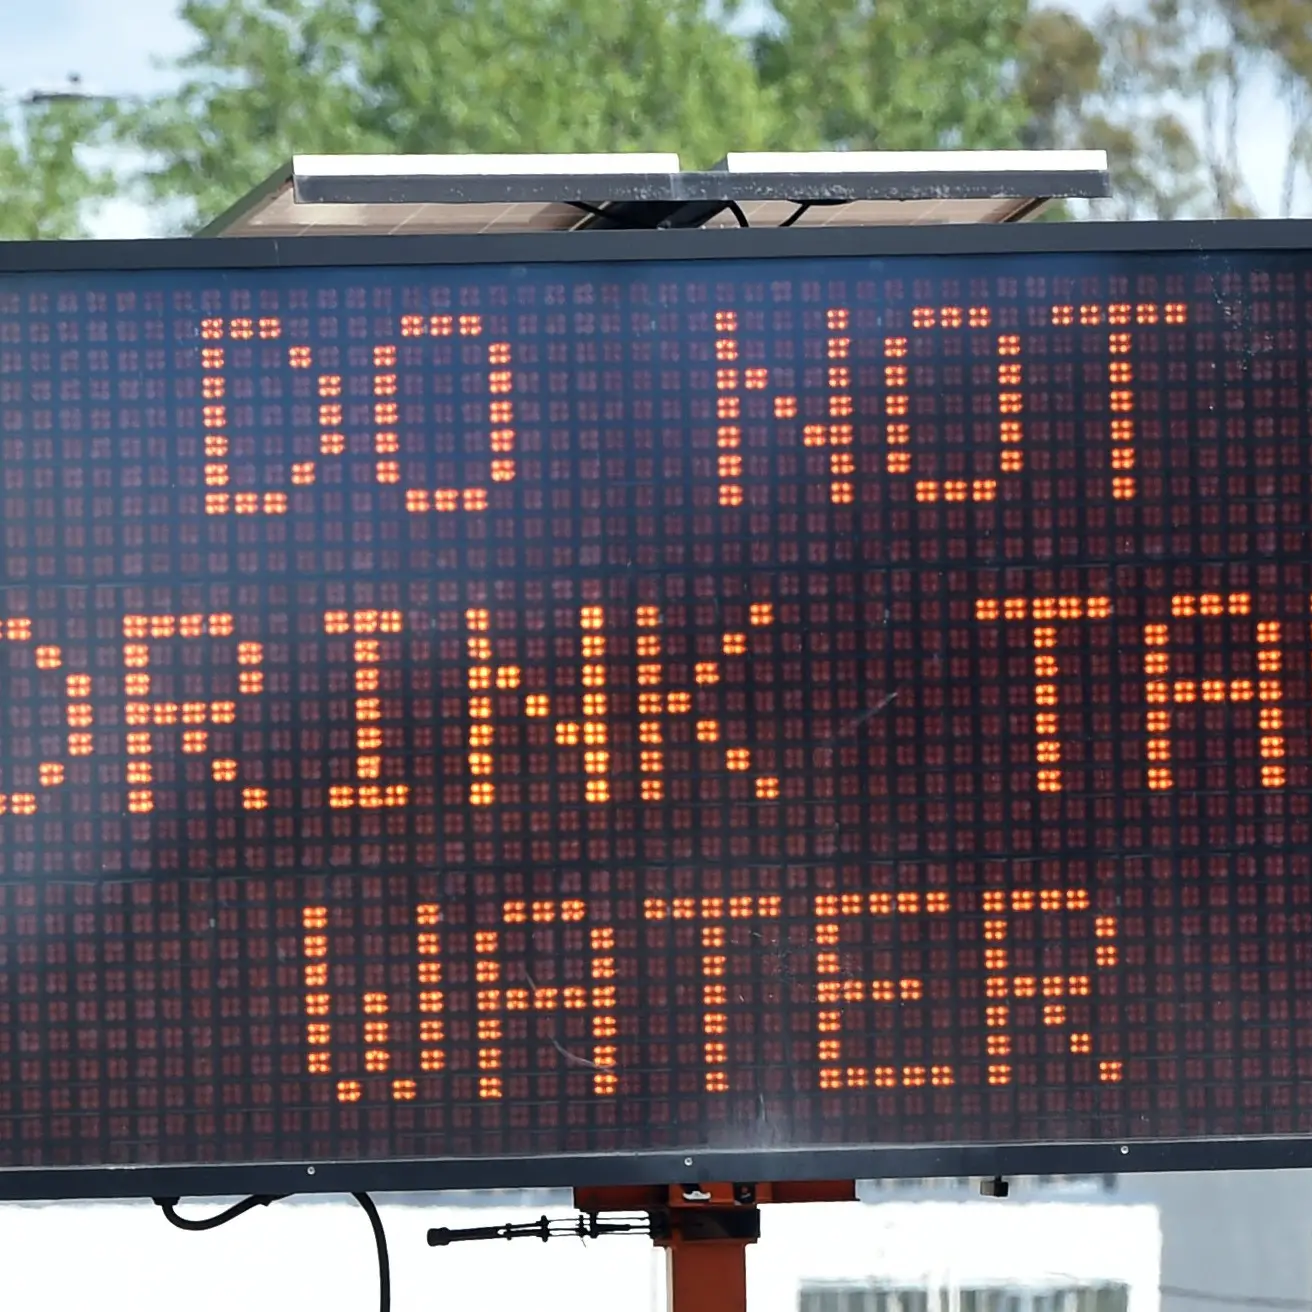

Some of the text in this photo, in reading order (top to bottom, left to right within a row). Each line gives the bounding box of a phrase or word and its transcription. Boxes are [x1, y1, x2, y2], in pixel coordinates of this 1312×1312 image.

[202, 303, 1187, 515] DO NOT
[0, 604, 779, 815] DRINK
[302, 889, 1123, 1102] WATER
